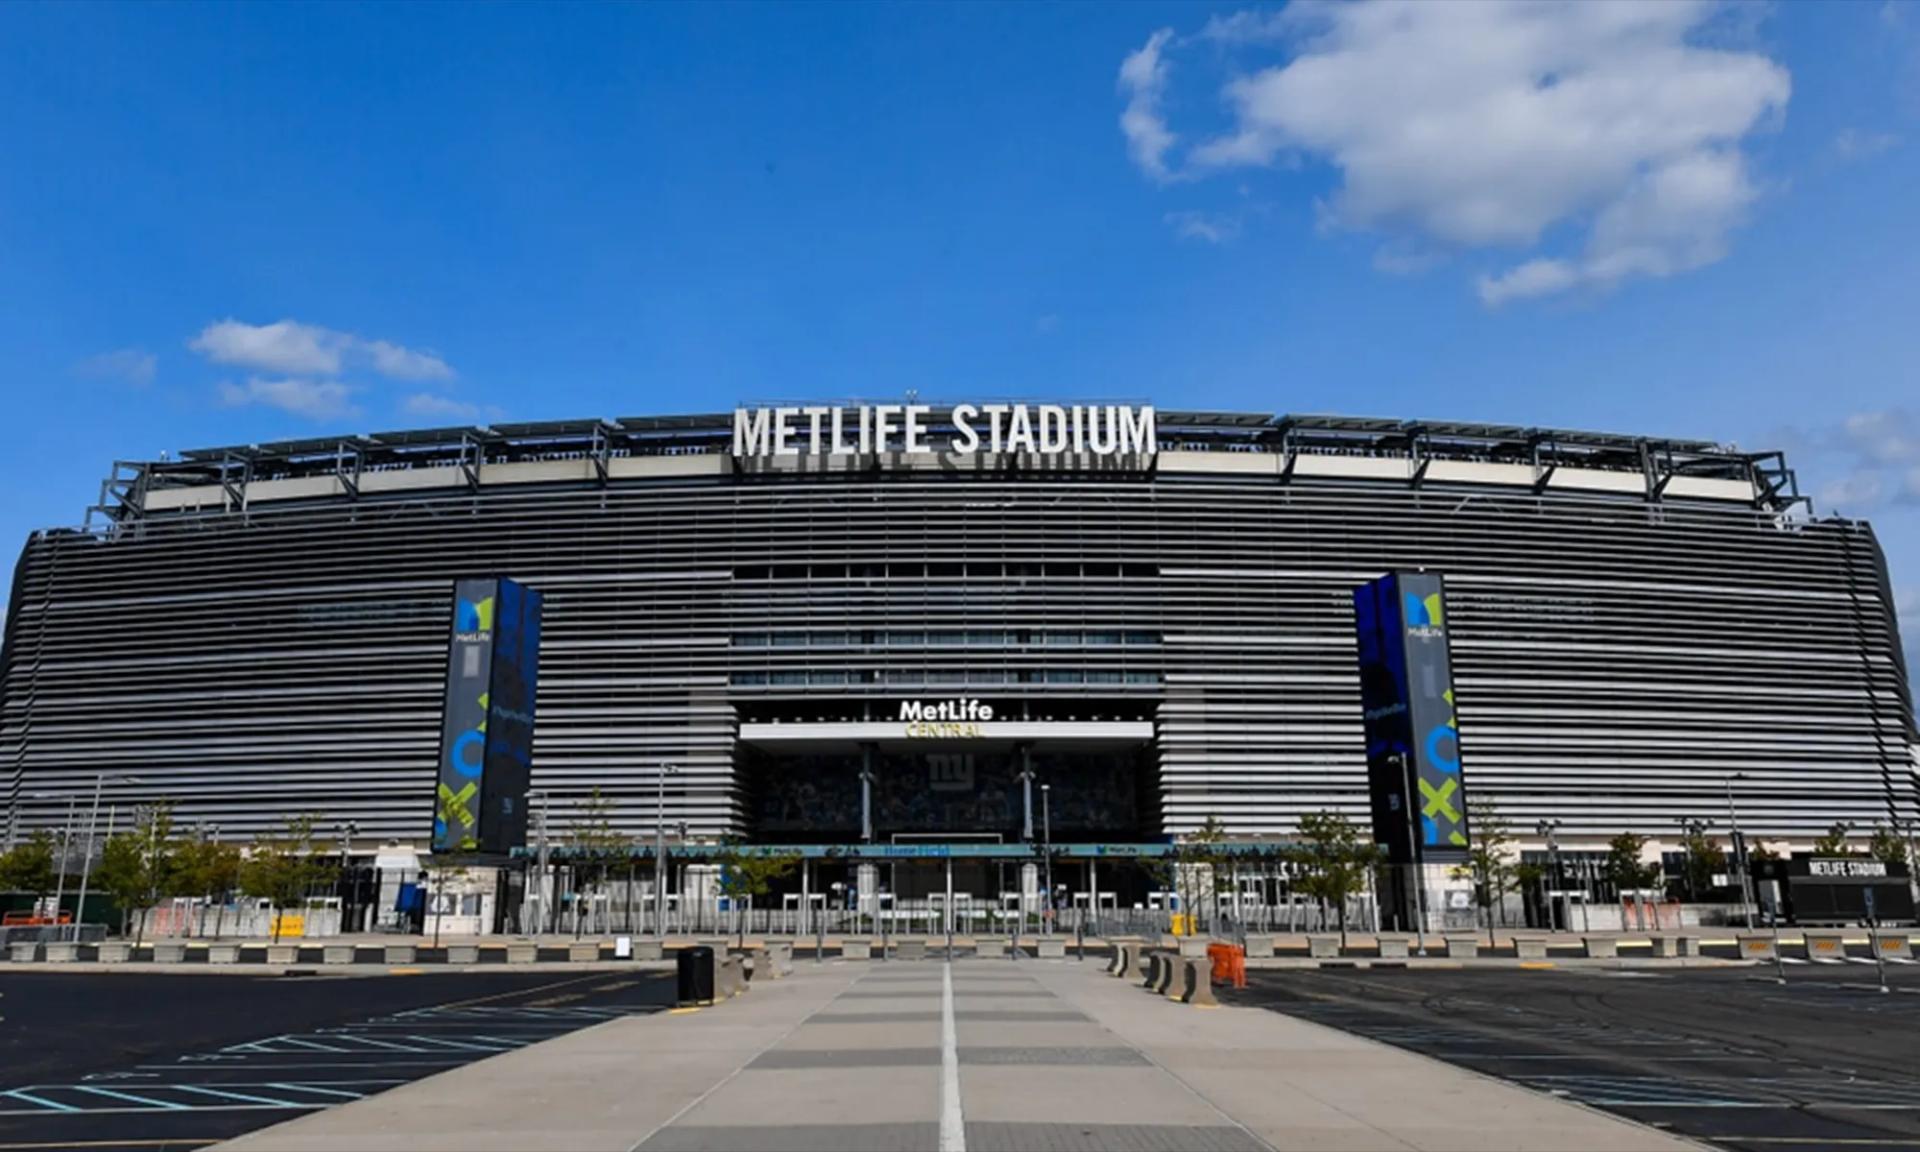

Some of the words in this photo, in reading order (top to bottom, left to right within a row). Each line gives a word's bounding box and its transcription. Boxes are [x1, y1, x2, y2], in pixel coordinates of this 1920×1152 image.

[733, 405, 930, 456] METLIFE
[952, 404, 1157, 455] STADIUM
[899, 698, 993, 720] MetLife
[905, 721, 984, 739] CENTRAL
[1808, 861, 1847, 877] METLIFE
